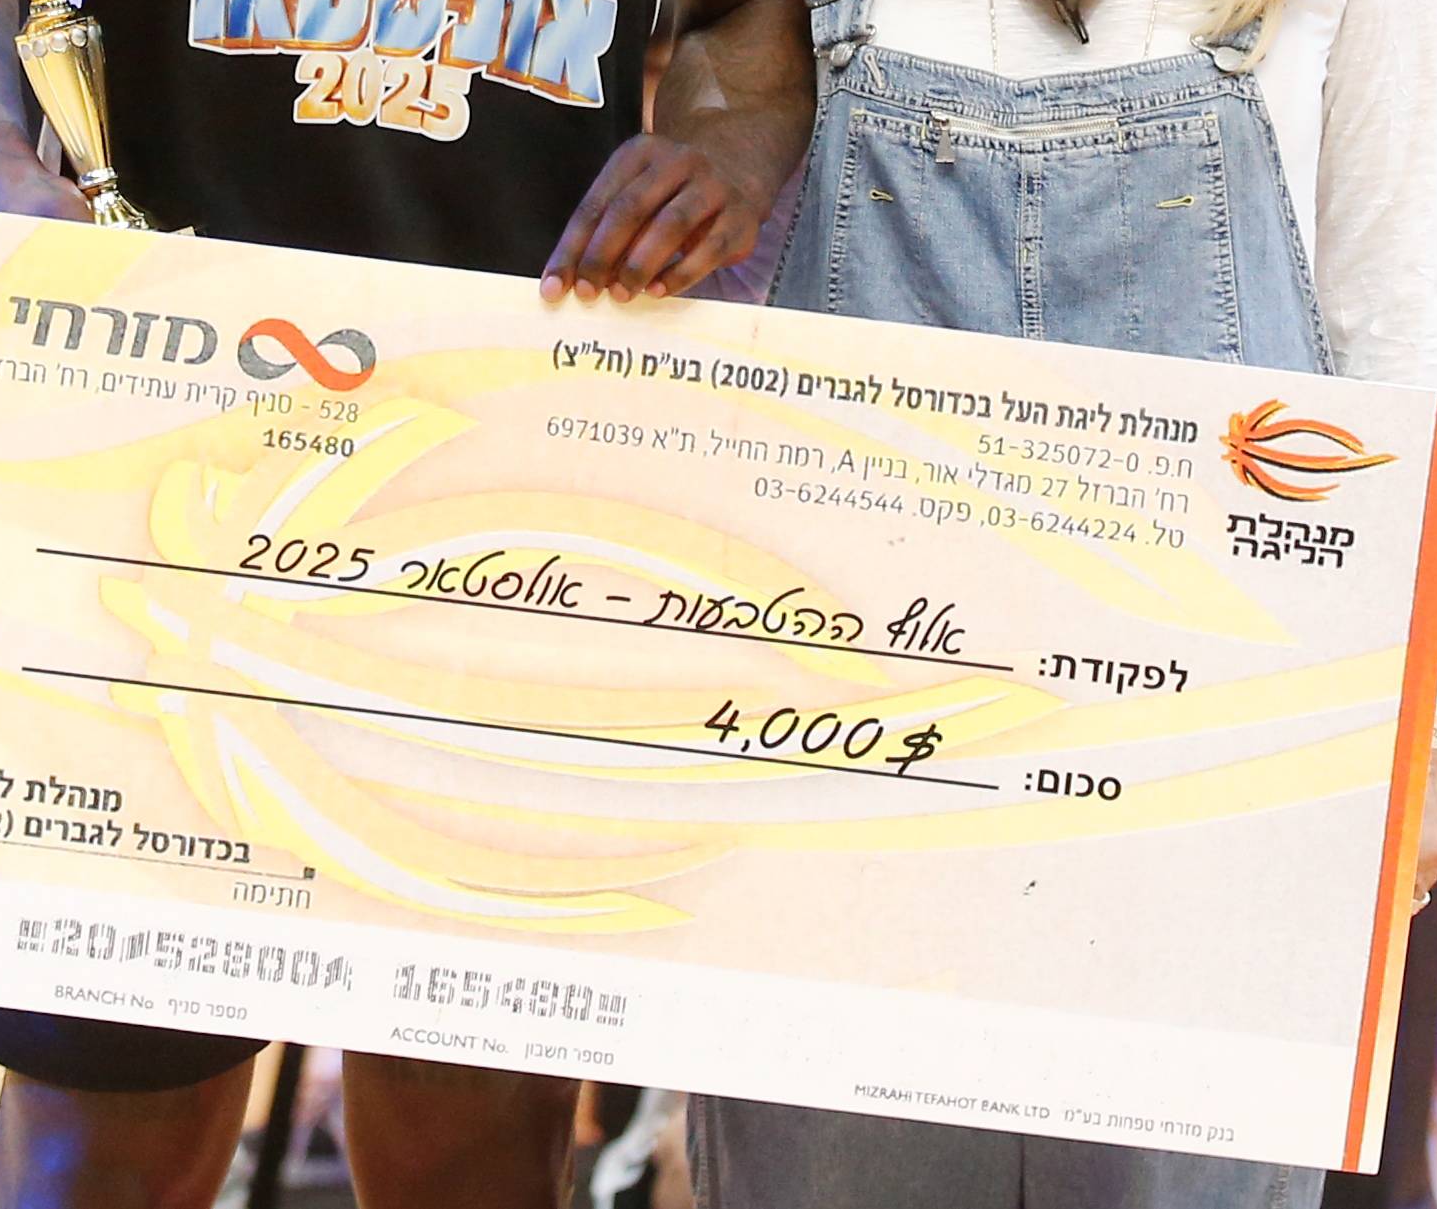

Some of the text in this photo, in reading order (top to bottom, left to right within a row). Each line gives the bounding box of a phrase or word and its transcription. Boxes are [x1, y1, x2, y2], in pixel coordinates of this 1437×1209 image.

[294, 52, 471, 141] 2025
[9, 296, 218, 365] מזרחי
[96, 372, 176, 399] עתידים,
[711, 359, 788, 398] (2002)
[797, 373, 882, 404] לגברים
[184, 383, 237, 413] קרית
[246, 390, 292, 417] סניף
[319, 400, 358, 423] 528
[892, 377, 991, 418] בכדורסל
[1002, 391, 1048, 426] העל
[547, 416, 644, 447] 6971039
[1055, 403, 1112, 432] ליגת
[1118, 408, 1198, 443] מנהלת
[263, 428, 354, 458] 165480
[776, 444, 824, 469] רמת
[978, 434, 1139, 472] 51-325072-0
[863, 456, 907, 481] בניין
[968, 462, 1031, 494] מגדלי
[754, 477, 903, 513] 03-6244544
[1041, 477, 1069, 498] 27
[1078, 474, 1145, 509] הברזל
[980, 506, 1136, 543] 03-6244224,
[1227, 513, 1355, 547] מנהלת
[239, 534, 375, 582] 2025
[1232, 535, 1345, 568] הליגה
[401, 551, 582, 608] אולסטאר
[643, 587, 864, 642] ההטבעות
[887, 597, 966, 655] אלוף
[1039, 654, 1188, 694] לפקודת:
[23, 776, 122, 812] מנהלת
[1025, 769, 1121, 801] סכום:
[23, 816, 123, 847] לגברים
[133, 823, 250, 864] בכדורסל
[234, 882, 310, 909] חתימה
[54, 985, 126, 1005] BRANCH
[168, 999, 247, 1020] מספר סניף
[390, 1027, 479, 1049] ACCOUNT
[525, 1043, 614, 1065] מספר חשבון
[855, 1084, 1050, 1119] MIZRAHI TEFAHOT BANK LTD
[1106, 1114, 1154, 1132] טפחות
[1160, 1121, 1202, 1137] מזרחי
[1207, 1126, 1234, 1143] בנק
